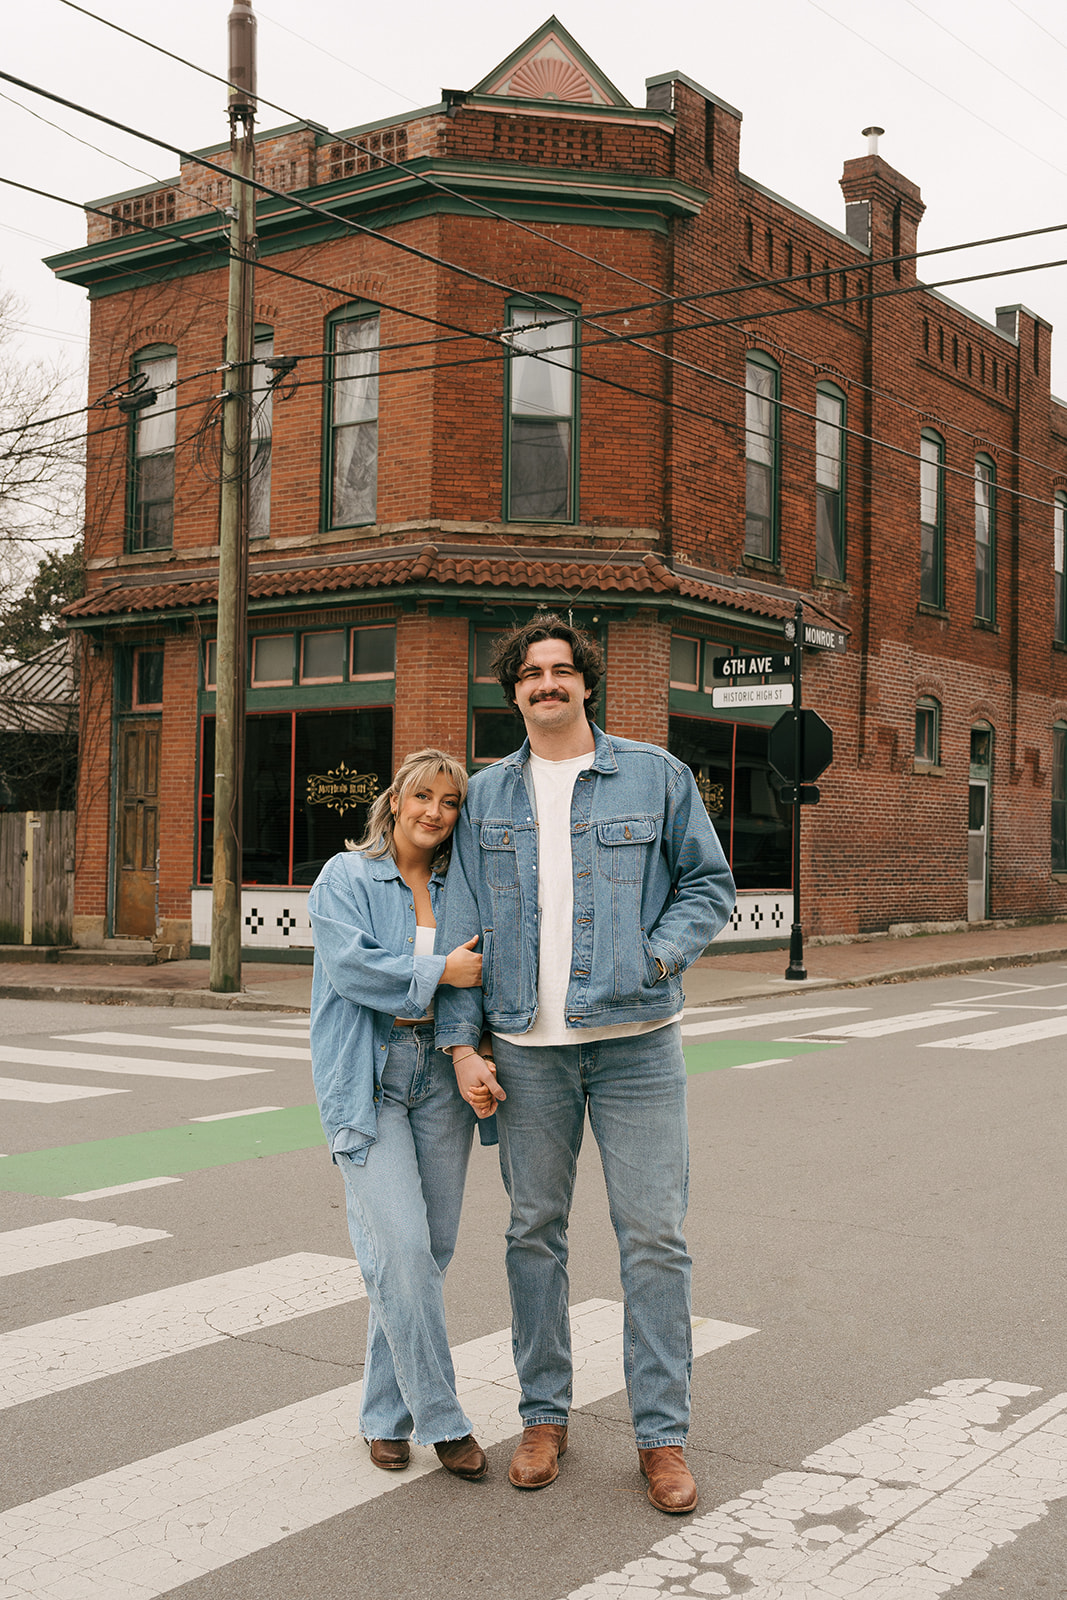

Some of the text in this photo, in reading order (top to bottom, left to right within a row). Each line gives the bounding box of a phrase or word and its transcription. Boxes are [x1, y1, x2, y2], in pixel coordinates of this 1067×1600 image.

[805, 626, 845, 649] MONROE ST
[722, 655, 790, 676] 6TH AVE N
[723, 689, 783, 703] HISTORIC HIGH ST
